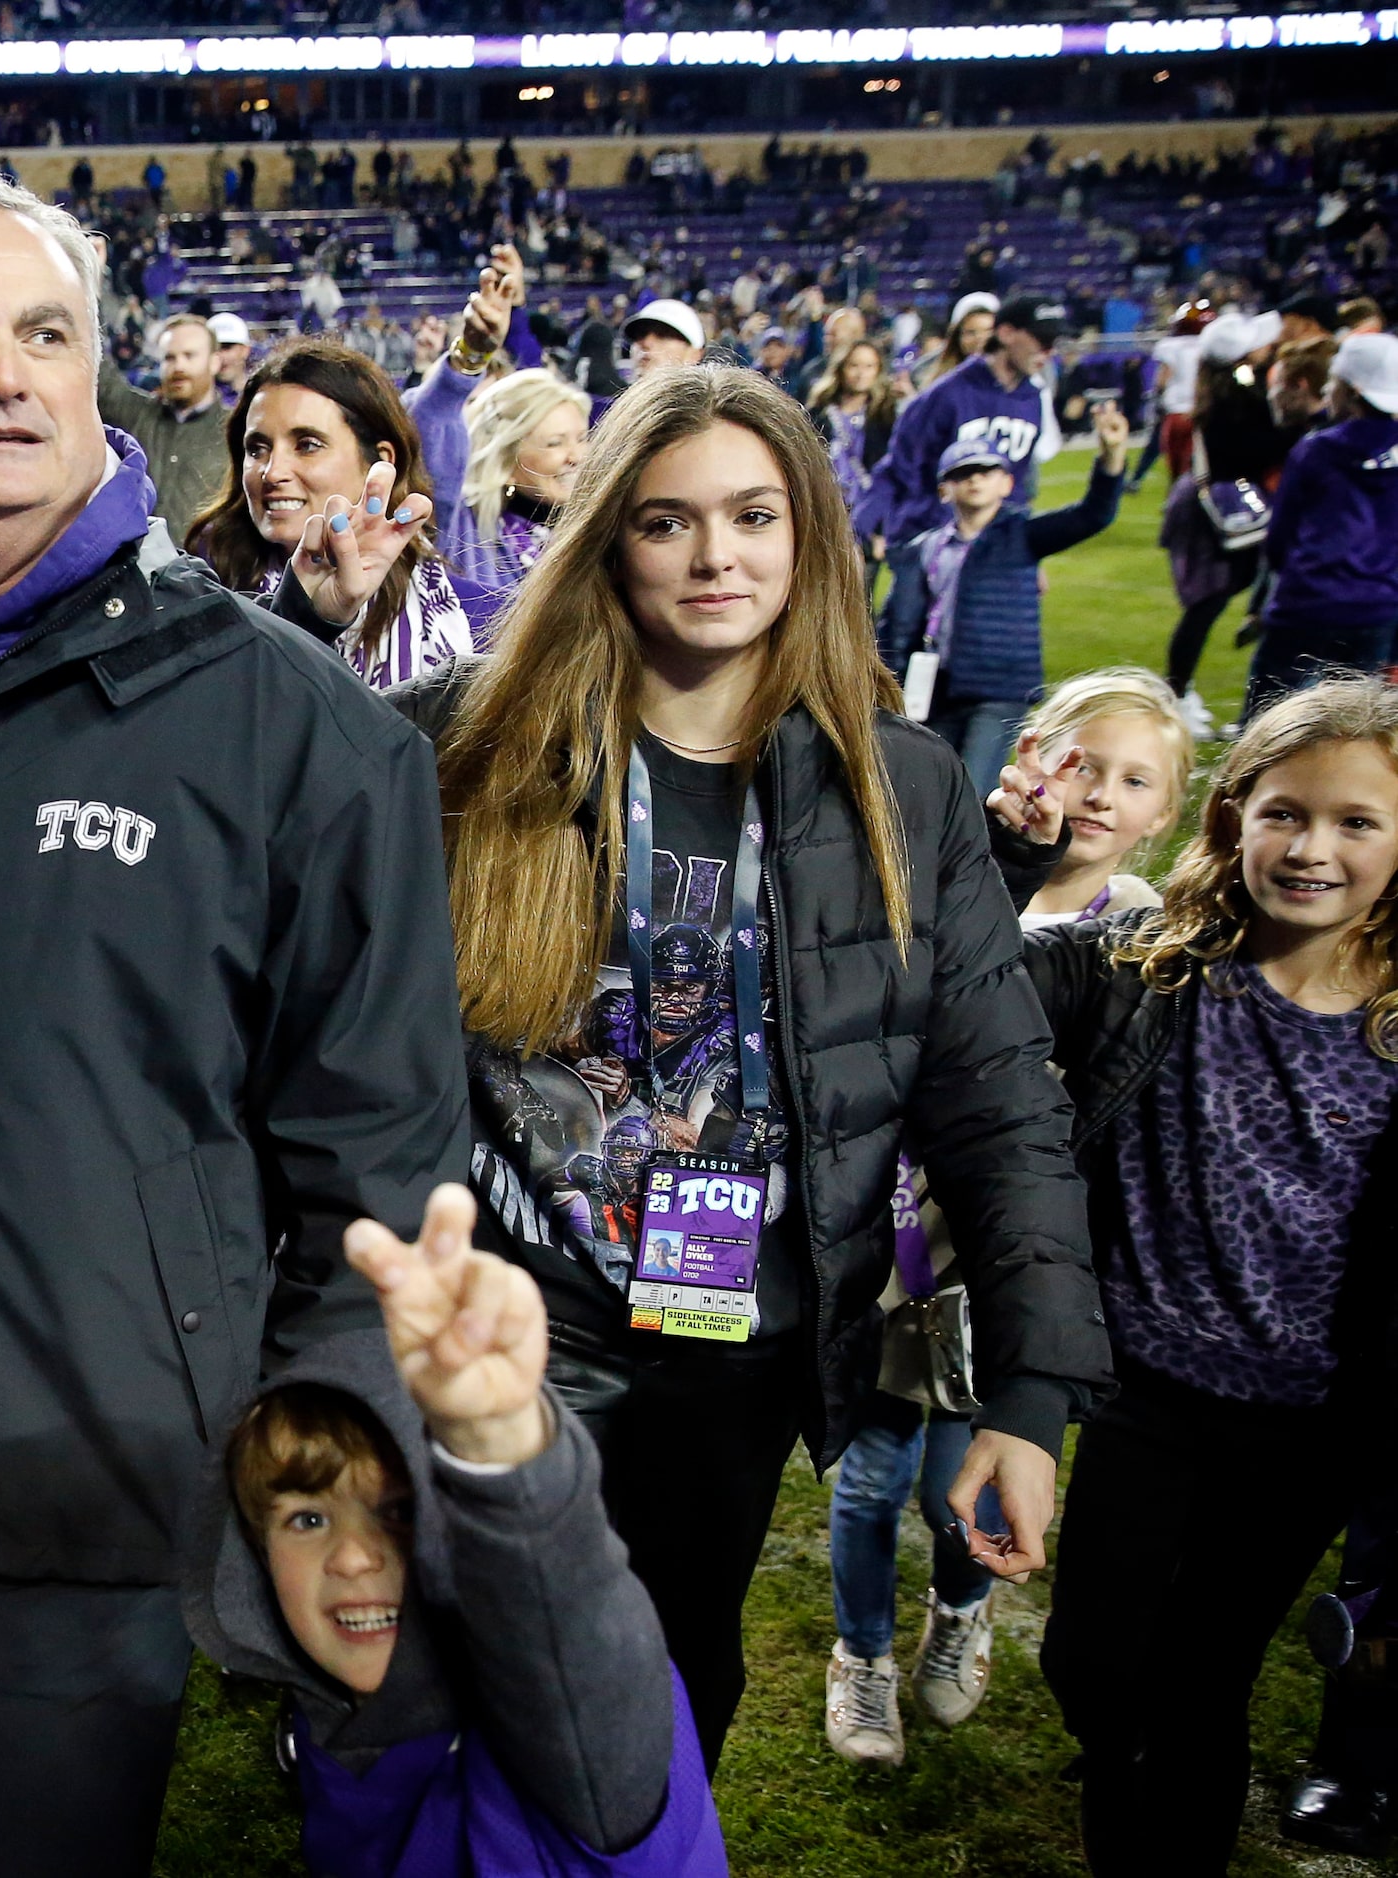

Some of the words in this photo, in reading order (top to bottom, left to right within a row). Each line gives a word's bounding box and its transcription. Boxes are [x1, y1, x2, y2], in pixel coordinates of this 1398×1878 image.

[1227, 16, 1273, 49] TO
[36, 800, 156, 866] TCU
[679, 1157, 740, 1173] SEASON
[651, 1172, 674, 1191] 22
[648, 1194, 670, 1213] 23
[678, 1178, 761, 1220] TCU
[686, 1244, 707, 1253] ALLY
[685, 1252, 714, 1262] DYKES
[684, 1262, 715, 1272] FOOTBALL
[667, 1311, 708, 1322] SIDELINE
[708, 1315, 742, 1325] ACCESS
[675, 1320, 687, 1328] AT
[687, 1321, 702, 1330] ALL
[704, 1323, 732, 1332] TIMES
